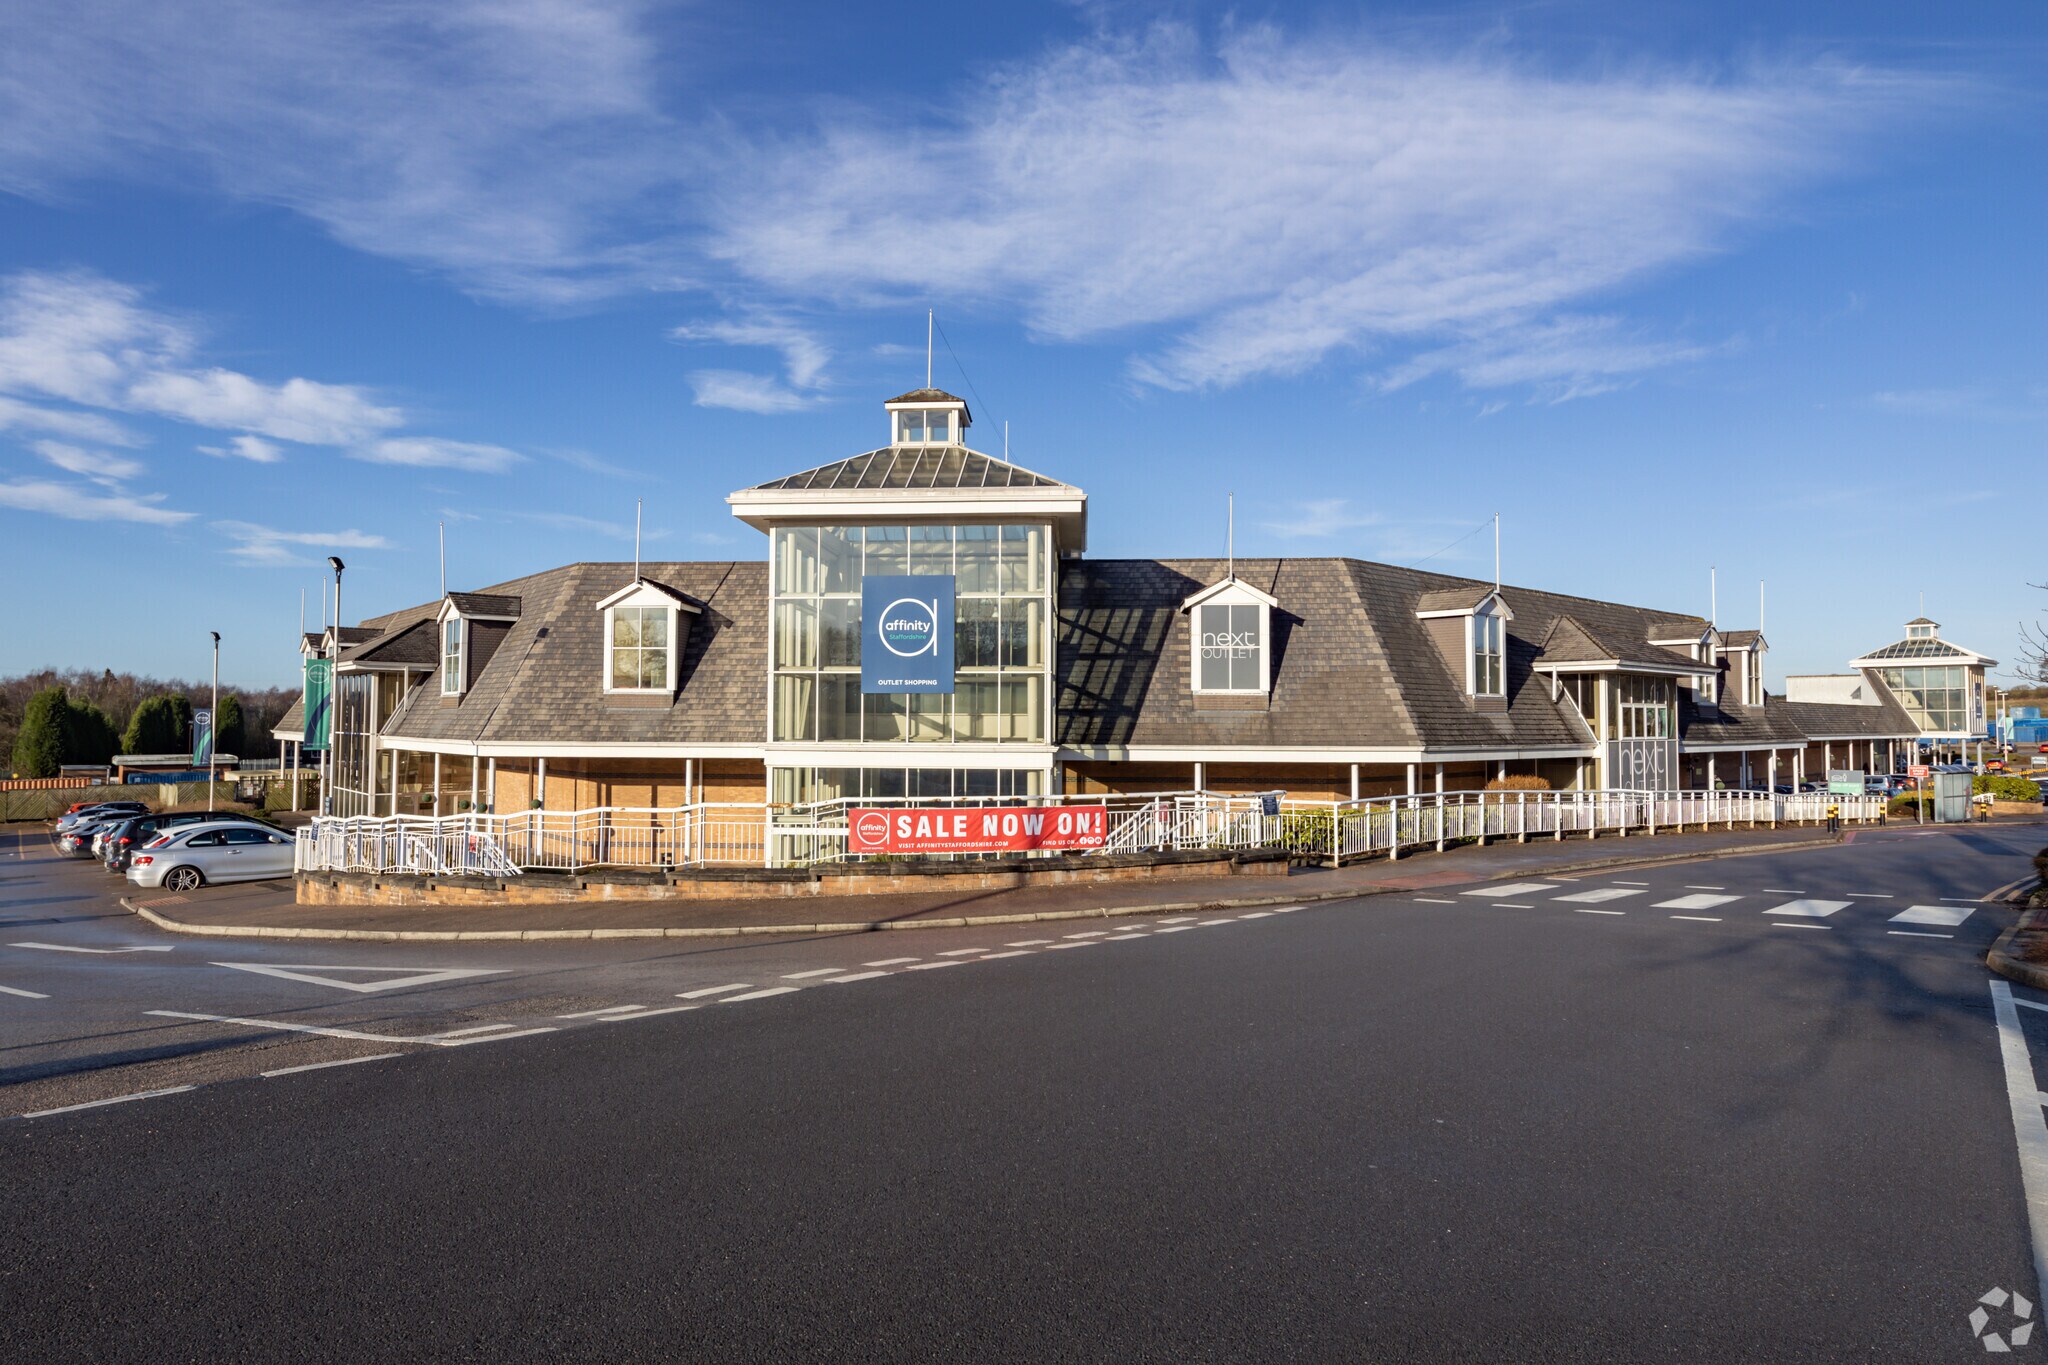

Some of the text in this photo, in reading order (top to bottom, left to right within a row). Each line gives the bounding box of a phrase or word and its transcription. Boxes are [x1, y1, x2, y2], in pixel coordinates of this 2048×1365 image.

[885, 619, 931, 632] affinity
[1203, 631, 1255, 646] next
[1202, 647, 1253, 658] OUTLET
[1621, 746, 1664, 775] next
[860, 824, 886, 832] affinity
[897, 812, 1101, 838] SALE NOW ON!
